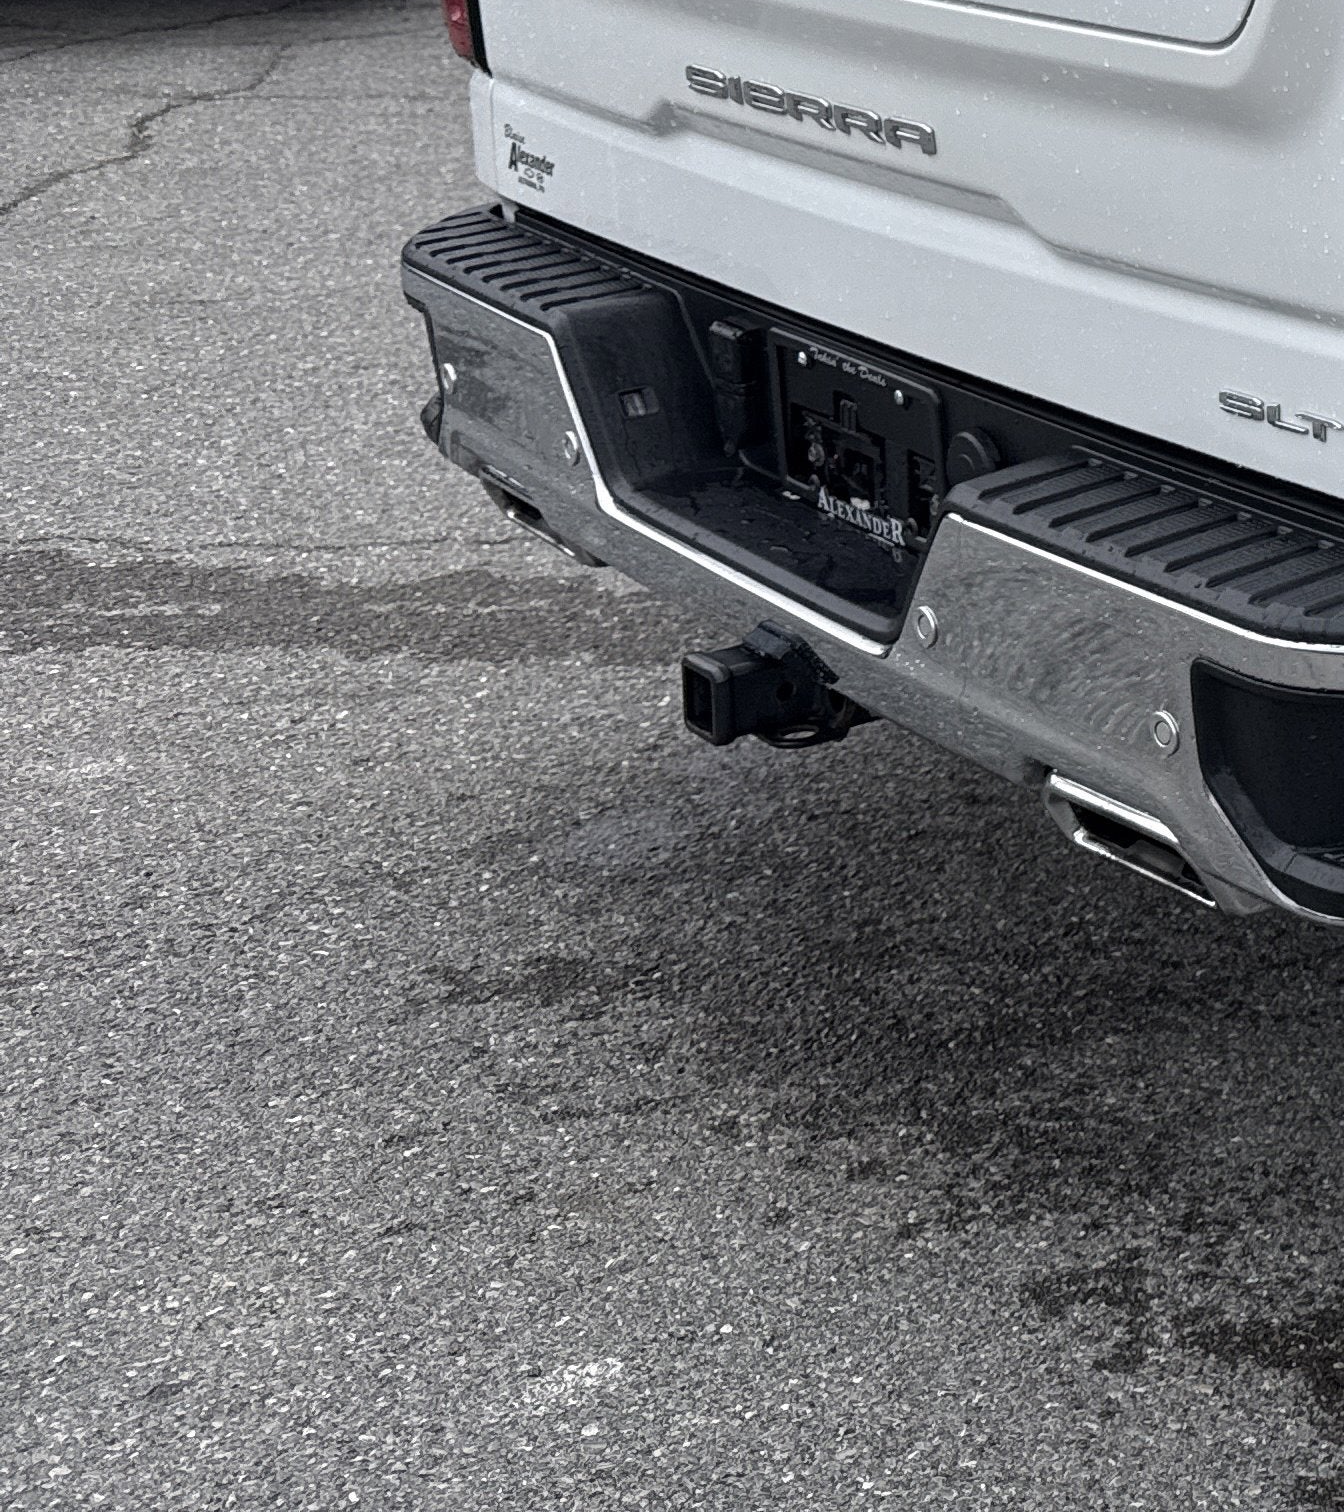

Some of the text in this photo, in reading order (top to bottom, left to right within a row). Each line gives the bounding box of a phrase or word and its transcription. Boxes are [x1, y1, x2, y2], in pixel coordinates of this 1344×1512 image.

[684, 64, 938, 157] SIERRA
[1217, 389, 1344, 444] SLT
[816, 485, 906, 547] ALEXANDER
